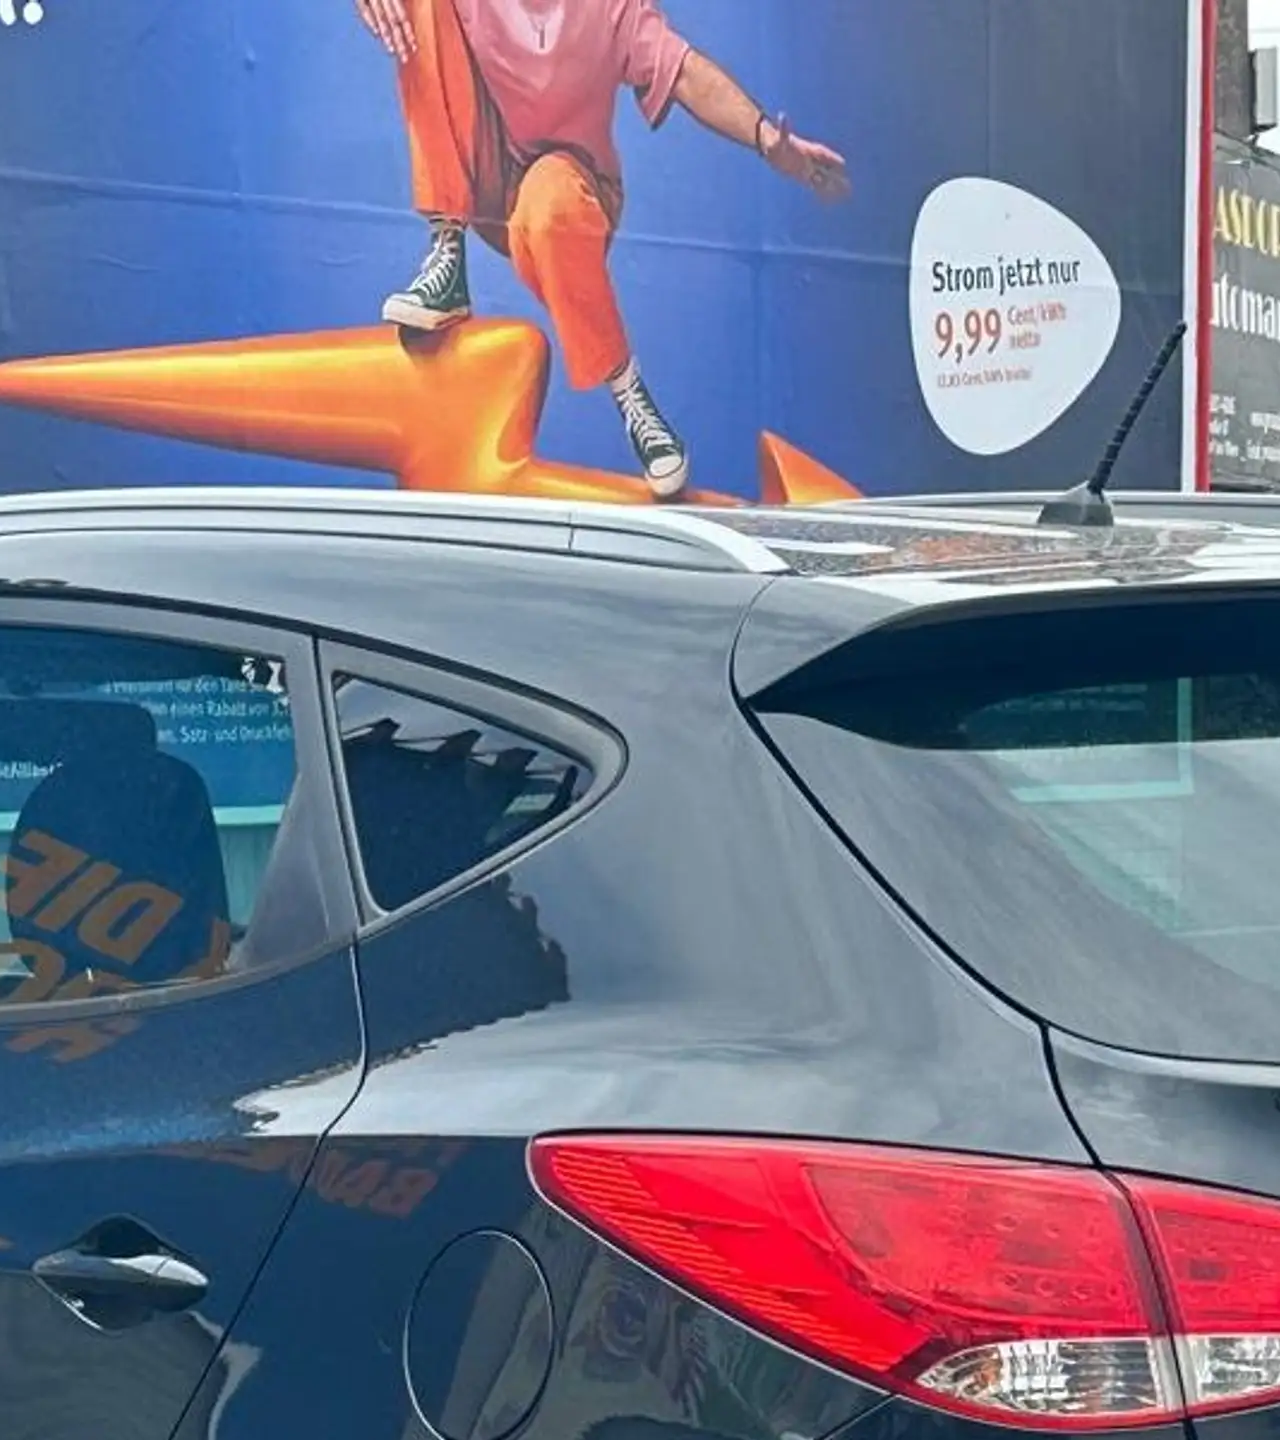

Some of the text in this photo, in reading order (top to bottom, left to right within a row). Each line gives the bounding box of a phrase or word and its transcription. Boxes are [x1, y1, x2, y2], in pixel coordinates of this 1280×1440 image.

[932, 256, 1080, 296] Strom jetzt nur
[934, 308, 1003, 363] 9,99
